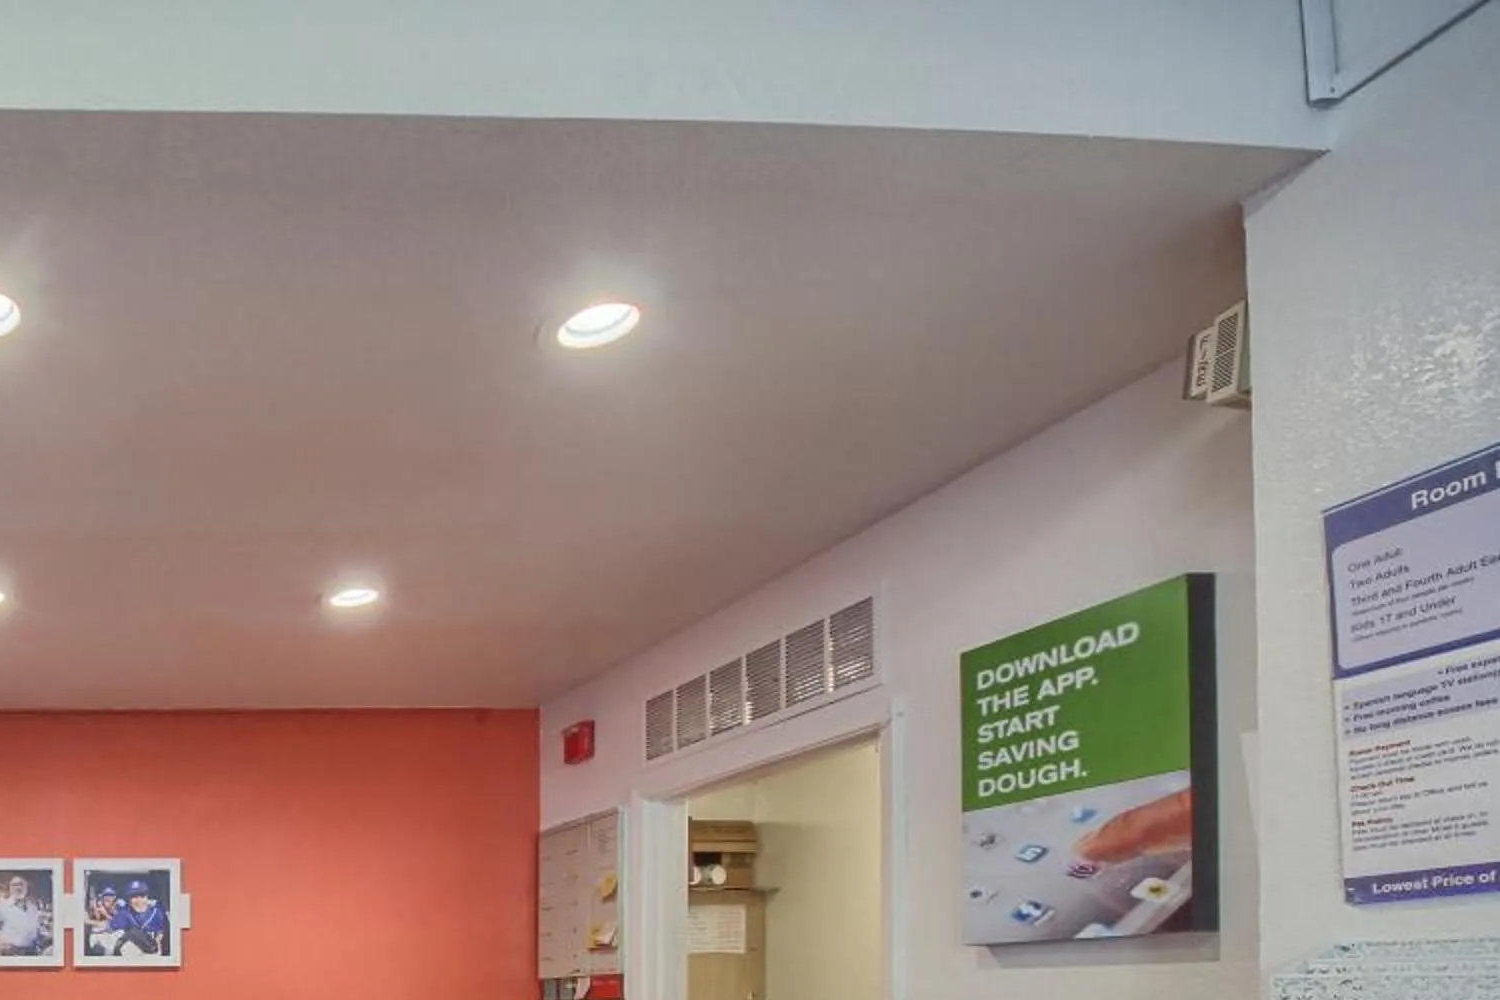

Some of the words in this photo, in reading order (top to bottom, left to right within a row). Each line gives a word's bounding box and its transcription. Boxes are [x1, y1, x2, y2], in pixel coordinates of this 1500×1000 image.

[1411, 471, 1487, 511] Room
[1375, 564, 1410, 581] Adults
[1405, 572, 1443, 590] Fourth
[1446, 560, 1477, 577] Adult
[976, 621, 1140, 691] DOWNLOAD
[977, 685, 1030, 716] THE
[1037, 667, 1098, 700] APP.
[977, 705, 1060, 743] START
[977, 730, 1080, 770] SAVING
[978, 759, 1088, 797] DOUGH.
[1373, 877, 1429, 894] Lowest
[1431, 872, 1475, 888] Price
[1479, 869, 1496, 883] of
